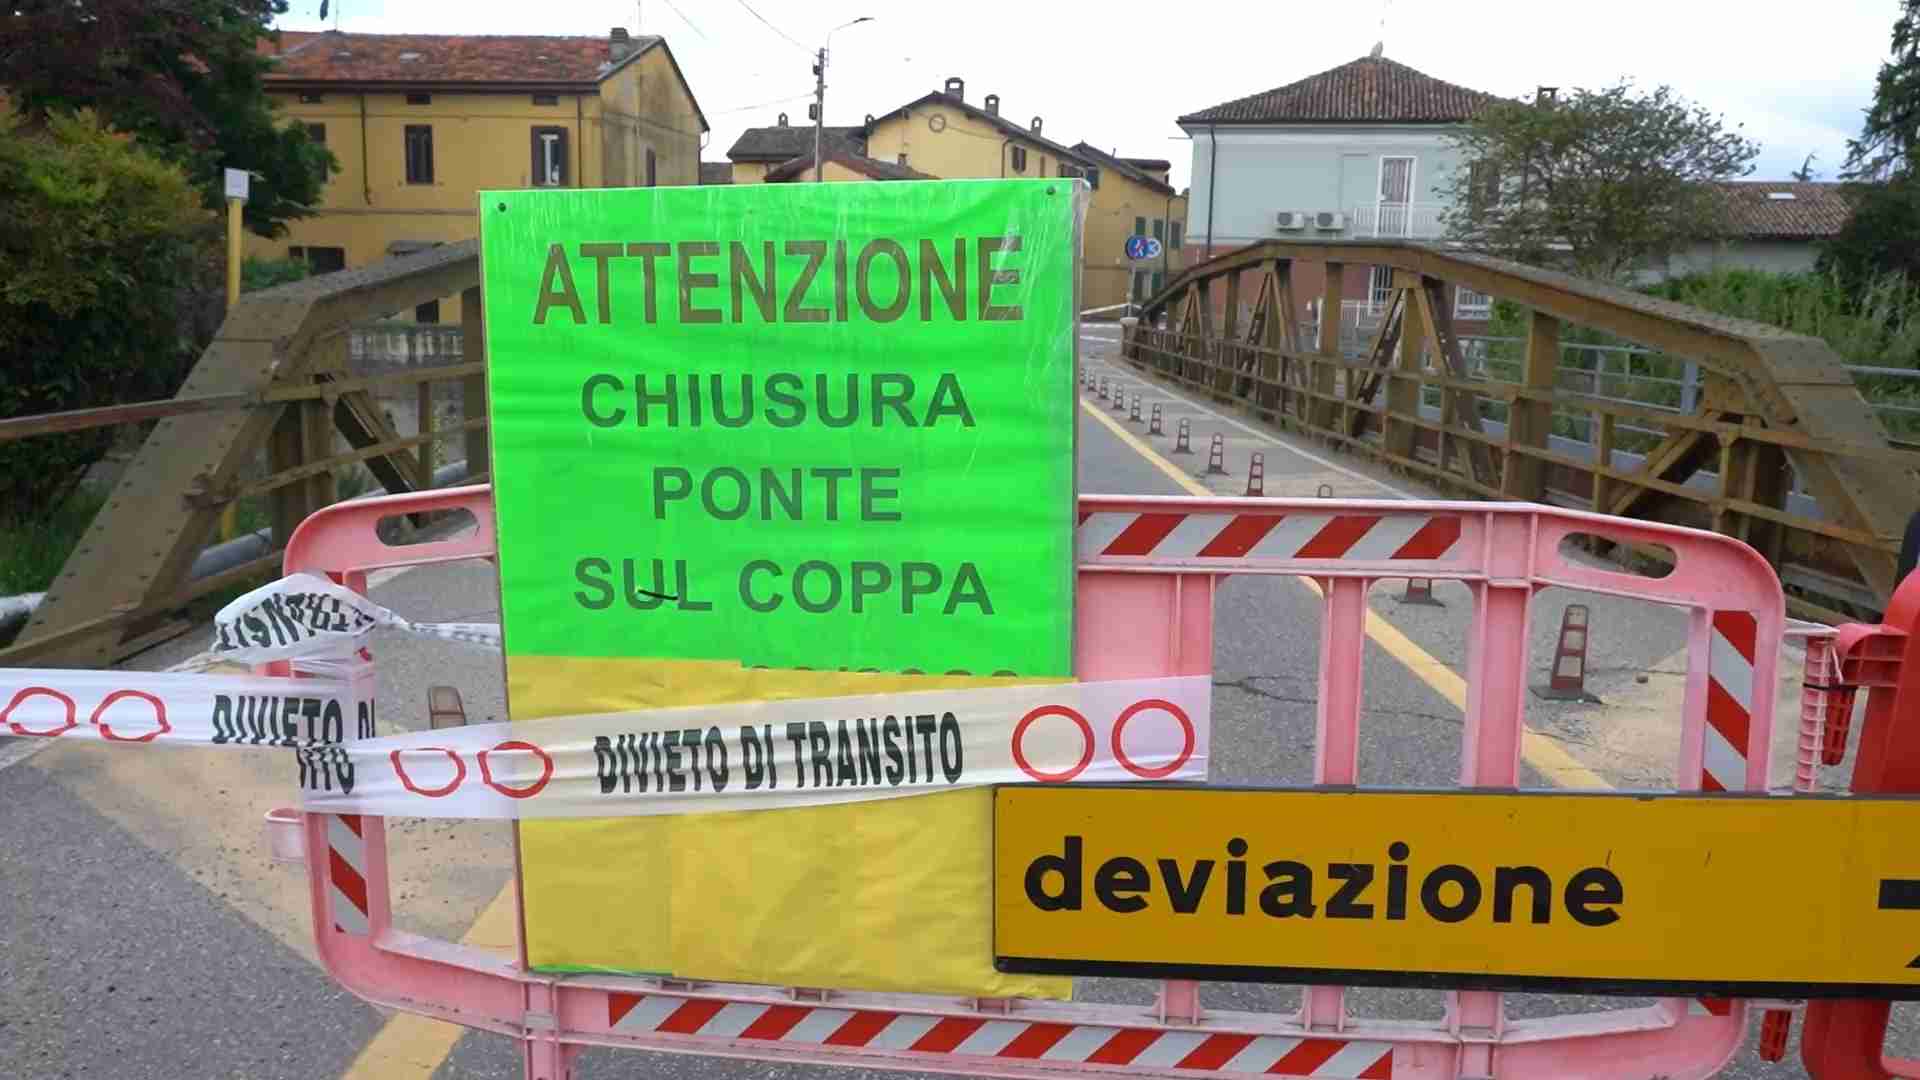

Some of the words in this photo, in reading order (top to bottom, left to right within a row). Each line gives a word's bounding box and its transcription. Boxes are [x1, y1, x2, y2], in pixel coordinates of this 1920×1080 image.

[533, 236, 1024, 325] ATTENZIONE
[580, 372, 977, 428] CHIUSURA
[652, 466, 903, 521] PONTE
[573, 557, 713, 611] SUL
[738, 559, 995, 616] COPPA
[212, 694, 344, 747] DIVIETO
[594, 725, 729, 794] DIVIETO
[740, 724, 777, 790] DI
[786, 711, 964, 788] TRANSITO
[1023, 835, 1625, 928] deviazione
